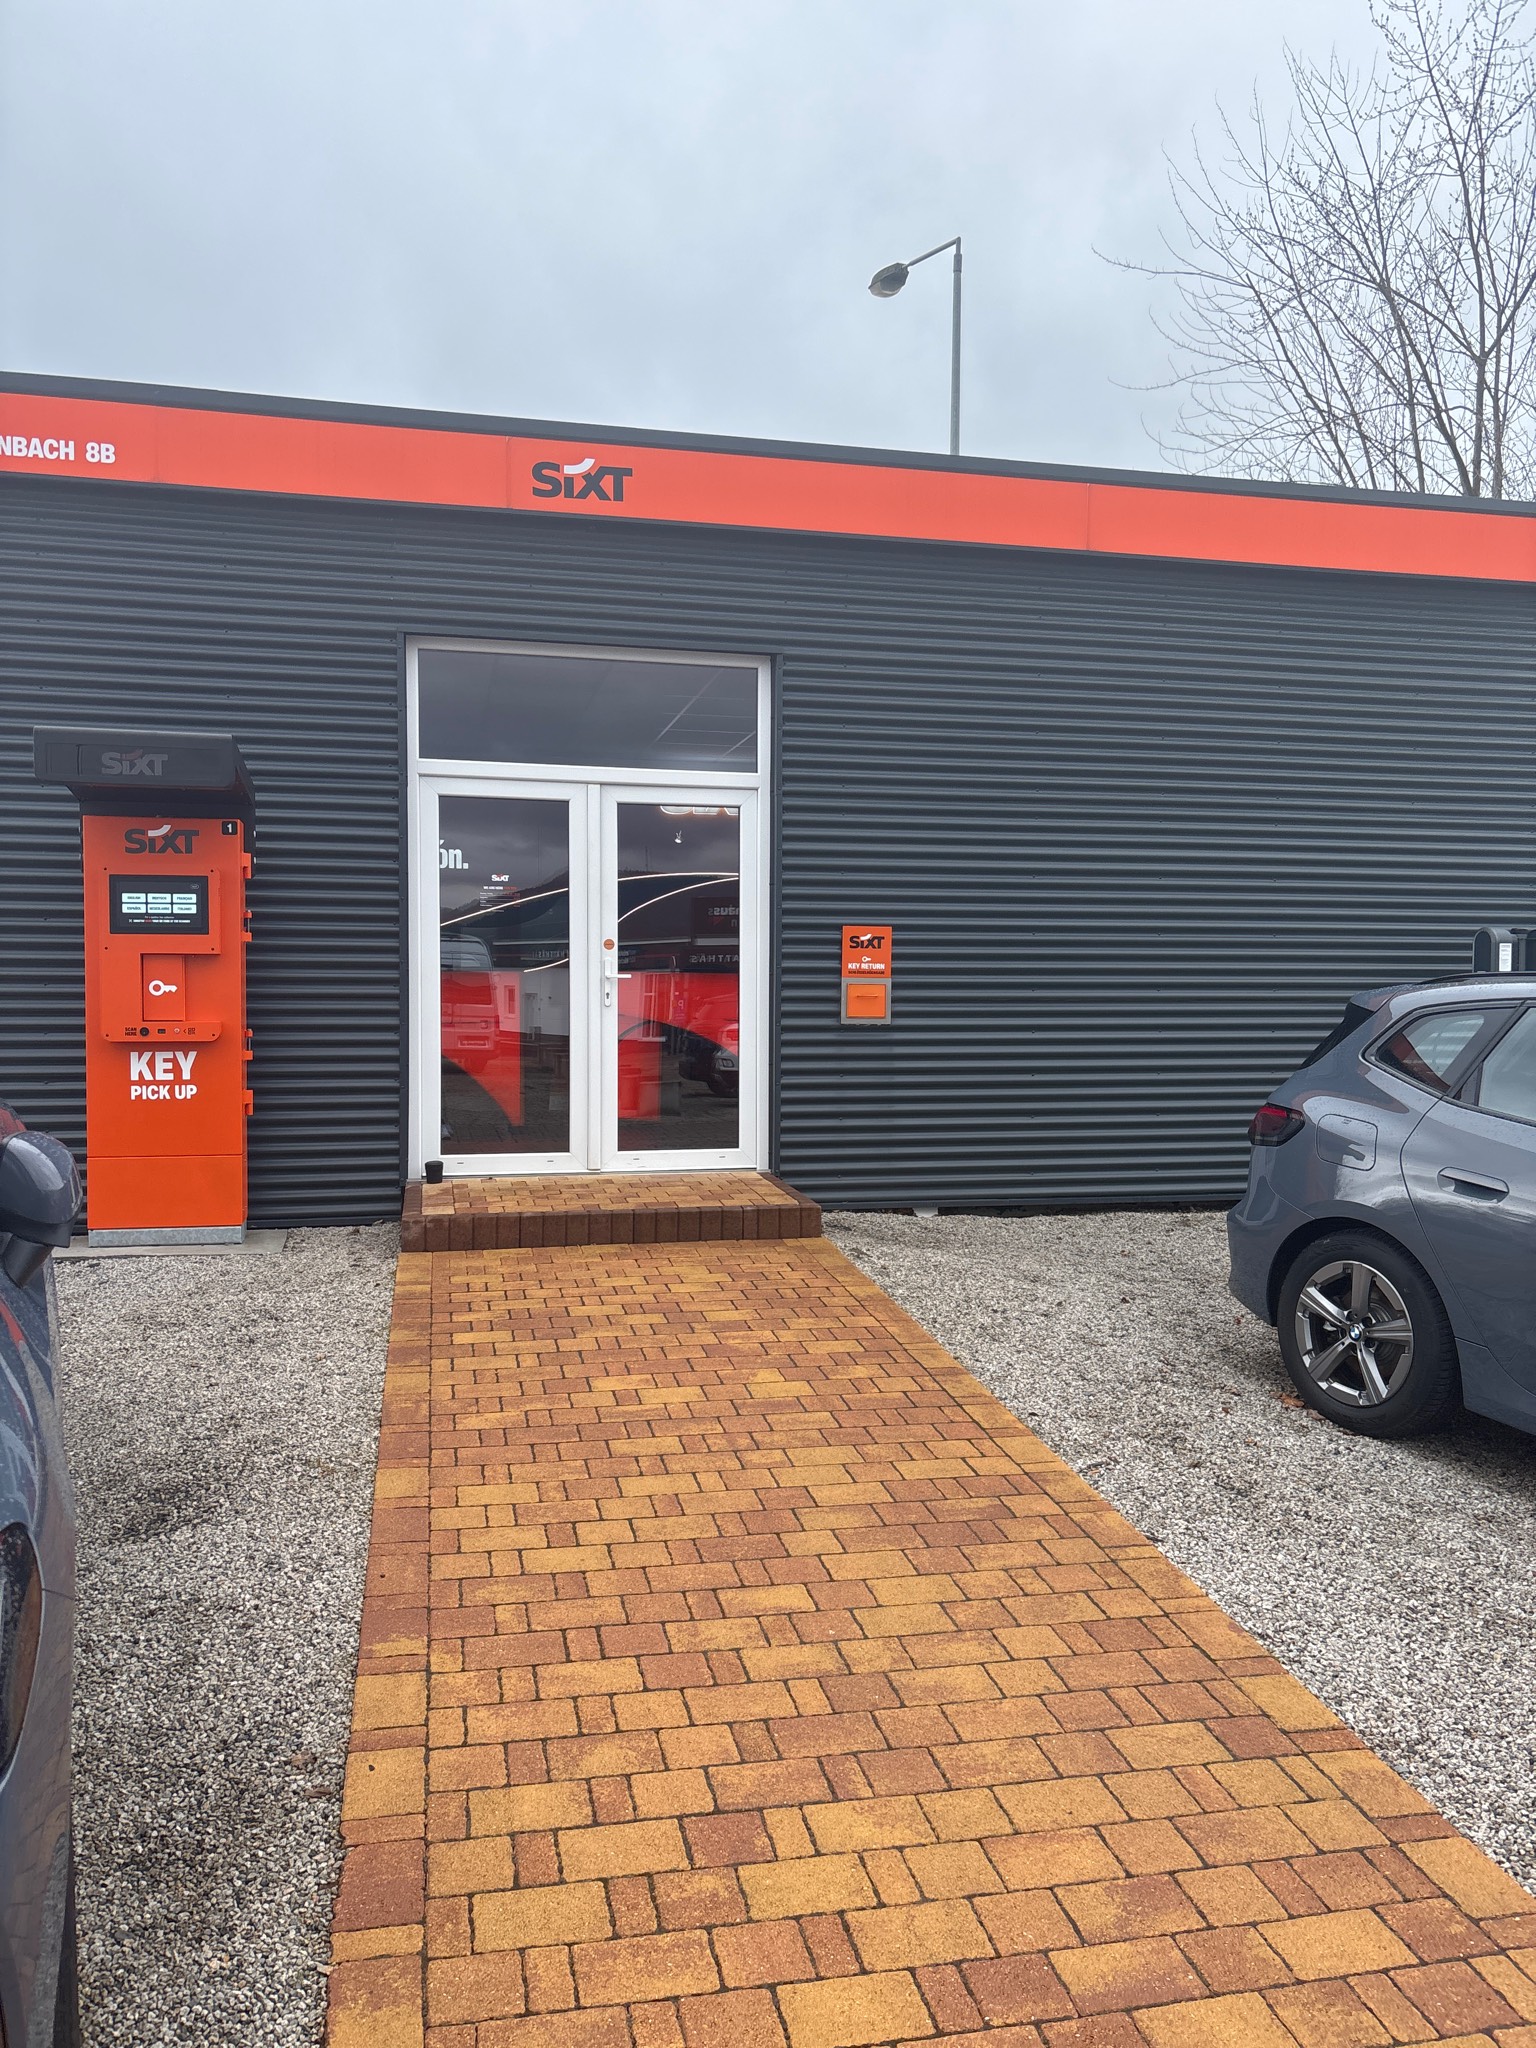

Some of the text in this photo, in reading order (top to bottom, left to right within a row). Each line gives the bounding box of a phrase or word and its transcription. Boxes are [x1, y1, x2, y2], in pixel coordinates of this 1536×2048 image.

[0, 435, 116, 464] NBACH 8B
[226, 823, 233, 833] 1
[130, 1051, 198, 1081] KEY
[130, 1085, 198, 1100] PICK UP
